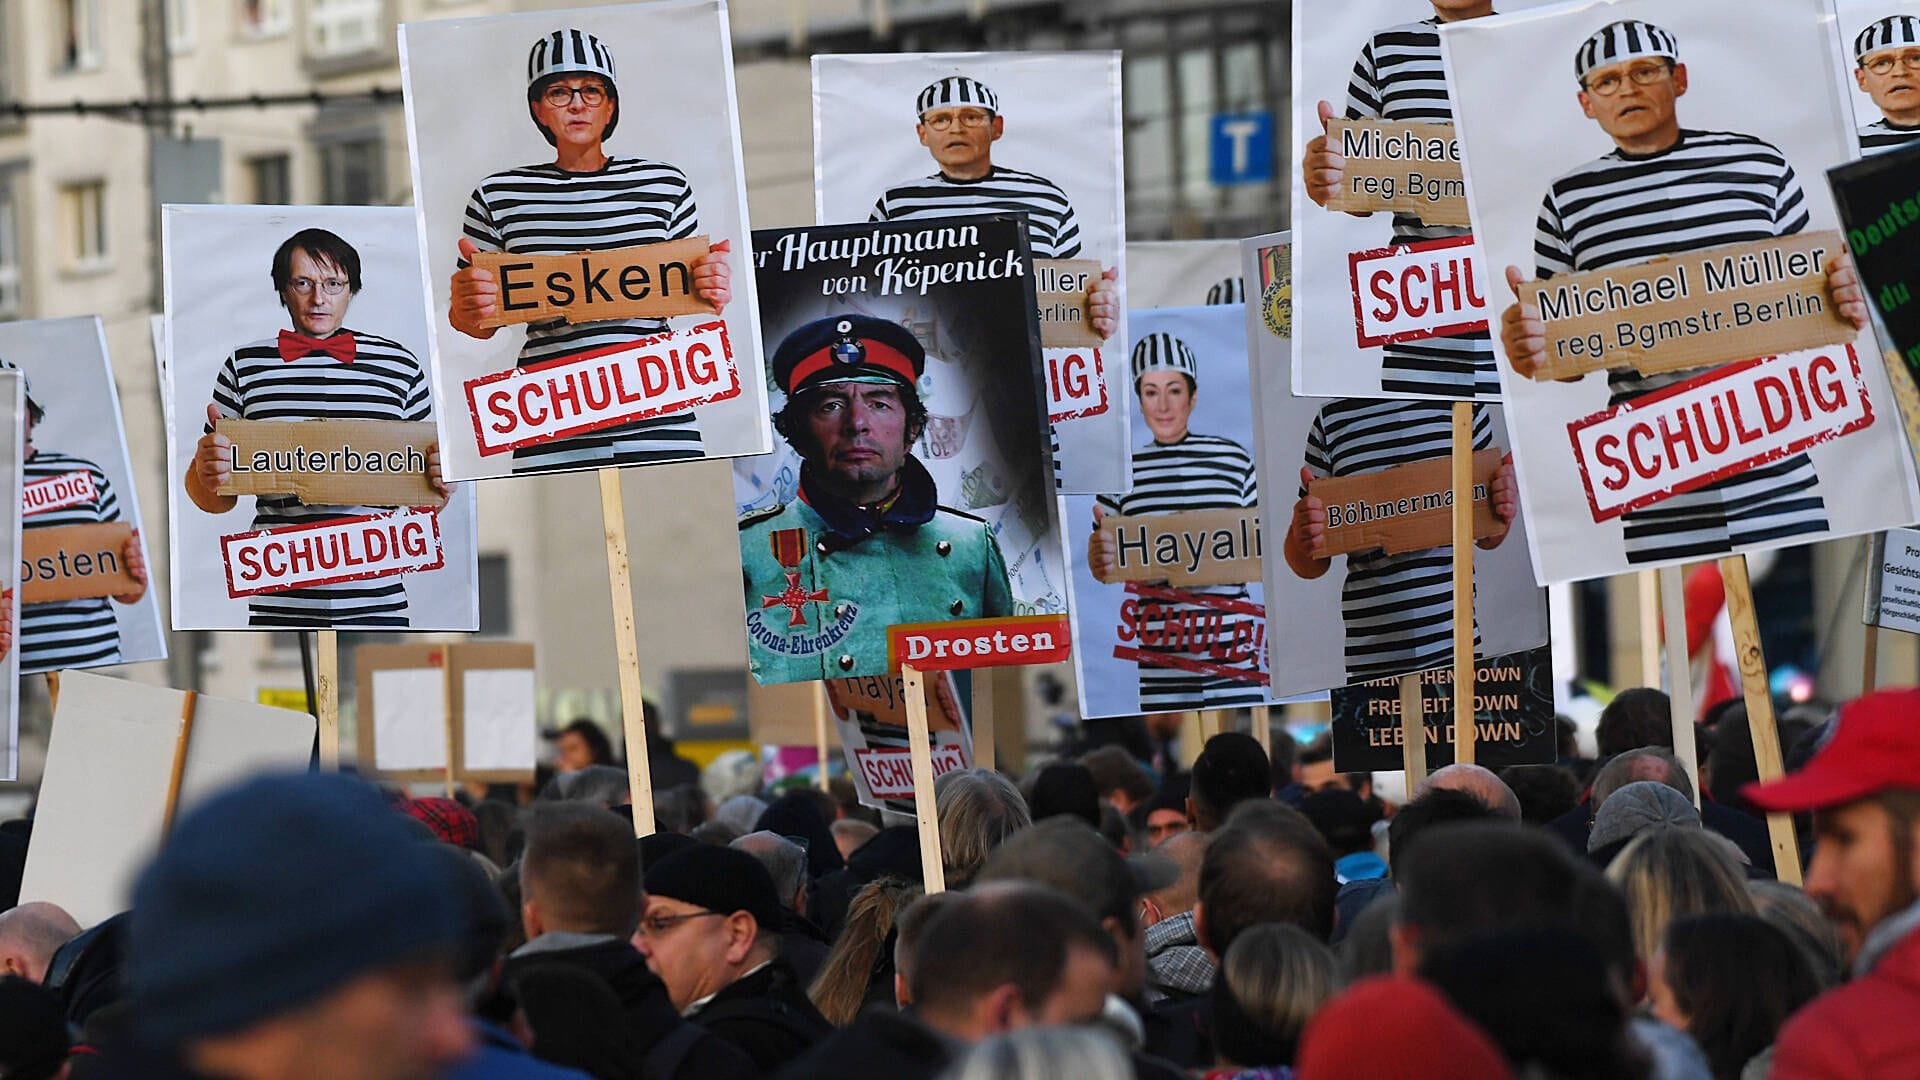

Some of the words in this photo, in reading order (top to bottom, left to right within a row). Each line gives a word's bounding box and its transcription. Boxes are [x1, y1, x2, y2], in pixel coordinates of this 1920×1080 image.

[1221, 121, 1258, 172] T
[776, 226, 978, 271] Hauptmann
[500, 258, 689, 311] Esken
[822, 275, 866, 295] von
[874, 249, 1024, 296] Köpenick
[1037, 268, 1088, 292] ller
[1537, 266, 1687, 321] Michael
[1703, 247, 1824, 292] Müller
[1879, 282, 1910, 312] du
[1556, 292, 1823, 357] reg.Bgmstr.Berlin
[487, 342, 718, 433] SCHULDIG
[1596, 356, 1848, 490] SCHULDIG
[230, 445, 426, 473] Lauterbach
[1328, 483, 1486, 528] Böhmerman
[238, 522, 427, 580] SCHULDIG
[1117, 518, 1262, 573] Hayali
[1884, 563, 1920, 579] Gesichts
[747, 604, 858, 655] Corona-Ehrenkreuz
[906, 631, 1054, 660] Drosten
[1117, 599, 1269, 668] SCHULDI
[1473, 667, 1520, 684] OWN
[1368, 696, 1450, 716] FREEIT
[1369, 725, 1439, 747] LEBN
